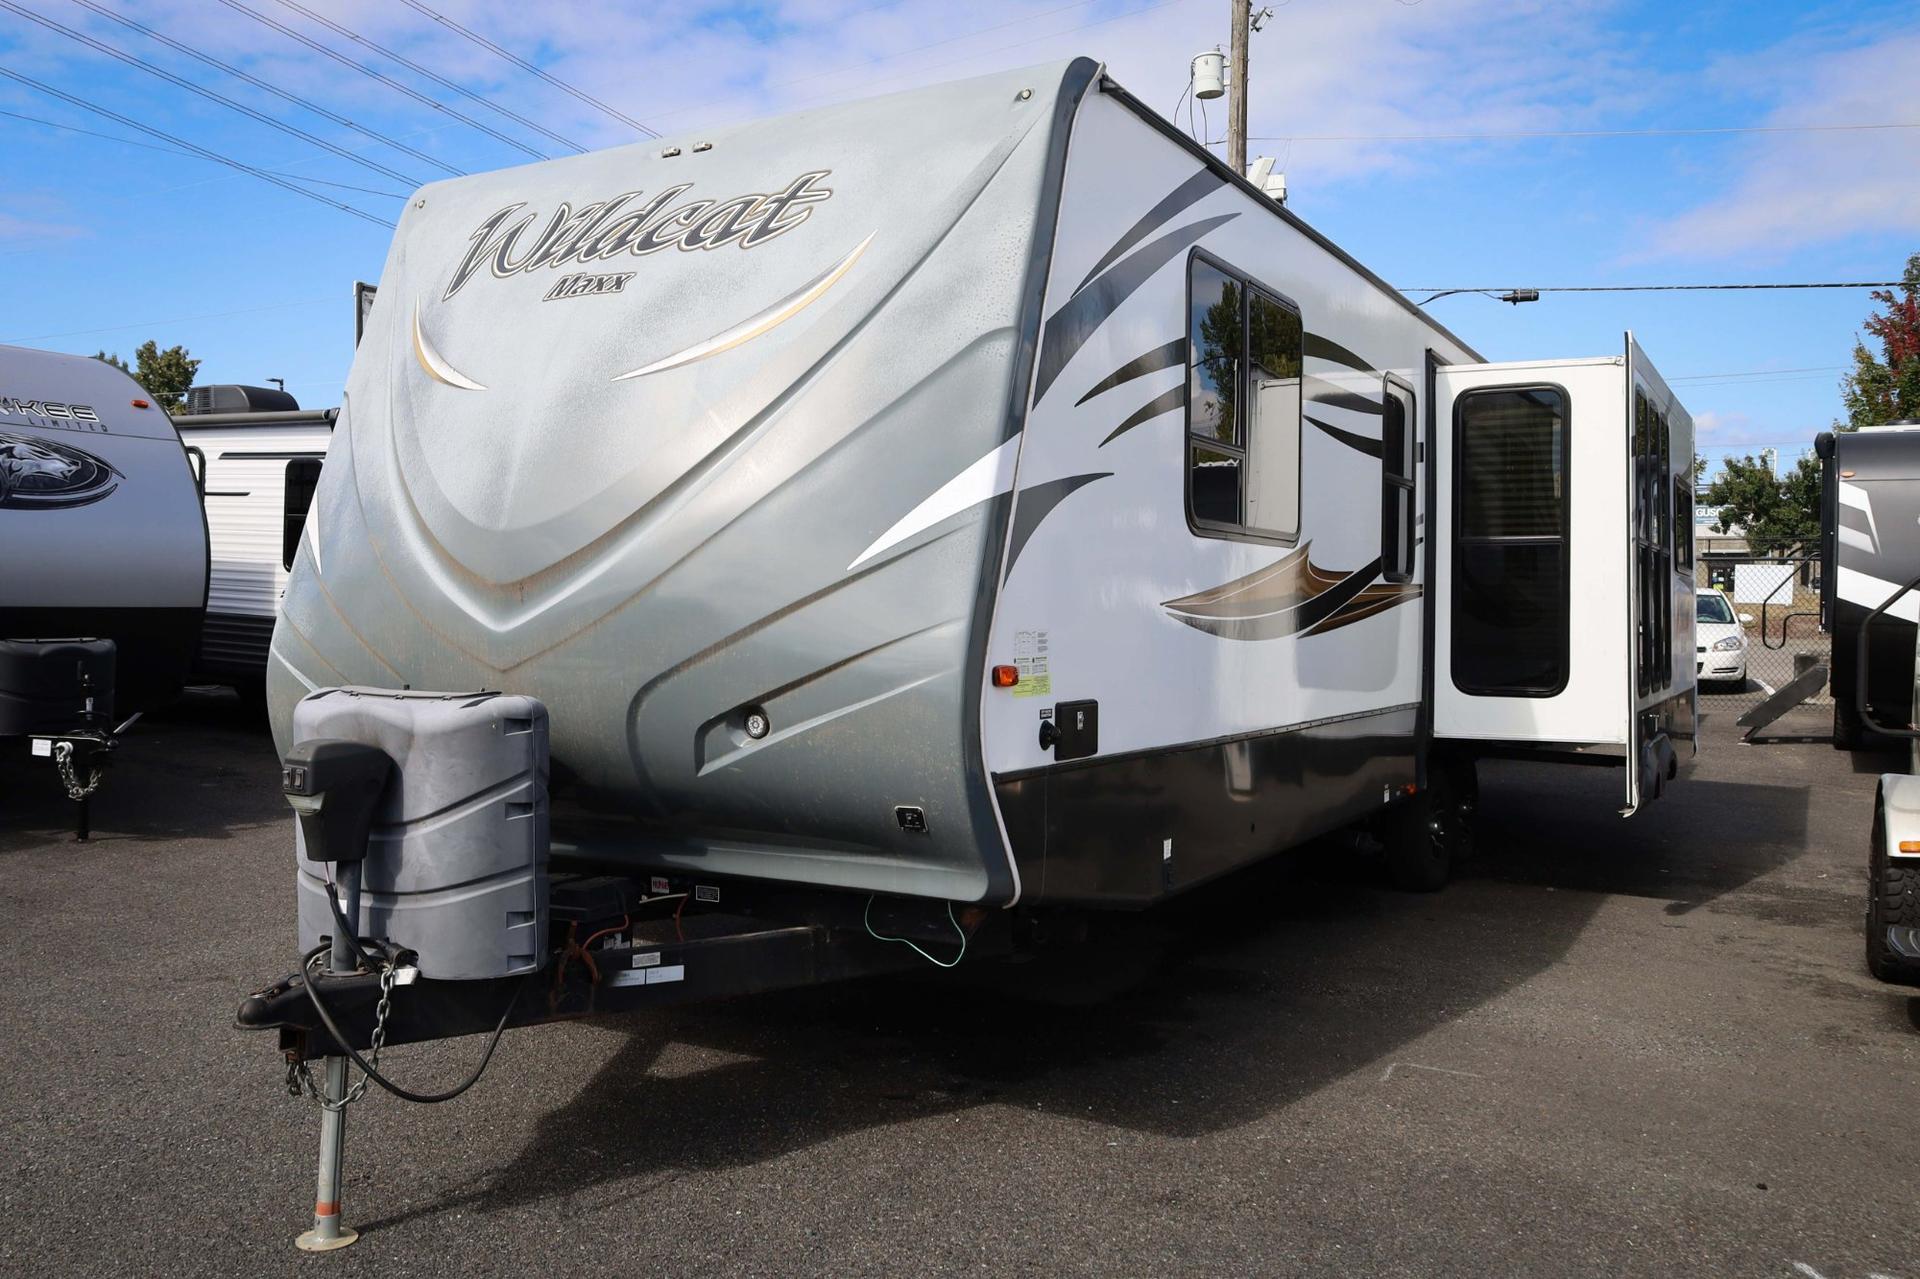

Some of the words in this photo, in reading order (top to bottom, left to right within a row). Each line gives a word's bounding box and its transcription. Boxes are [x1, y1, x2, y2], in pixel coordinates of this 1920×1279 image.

[443, 170, 832, 302] Wildcat
[542, 272, 637, 302] Maxx
[28, 417, 108, 432] LIMITED
